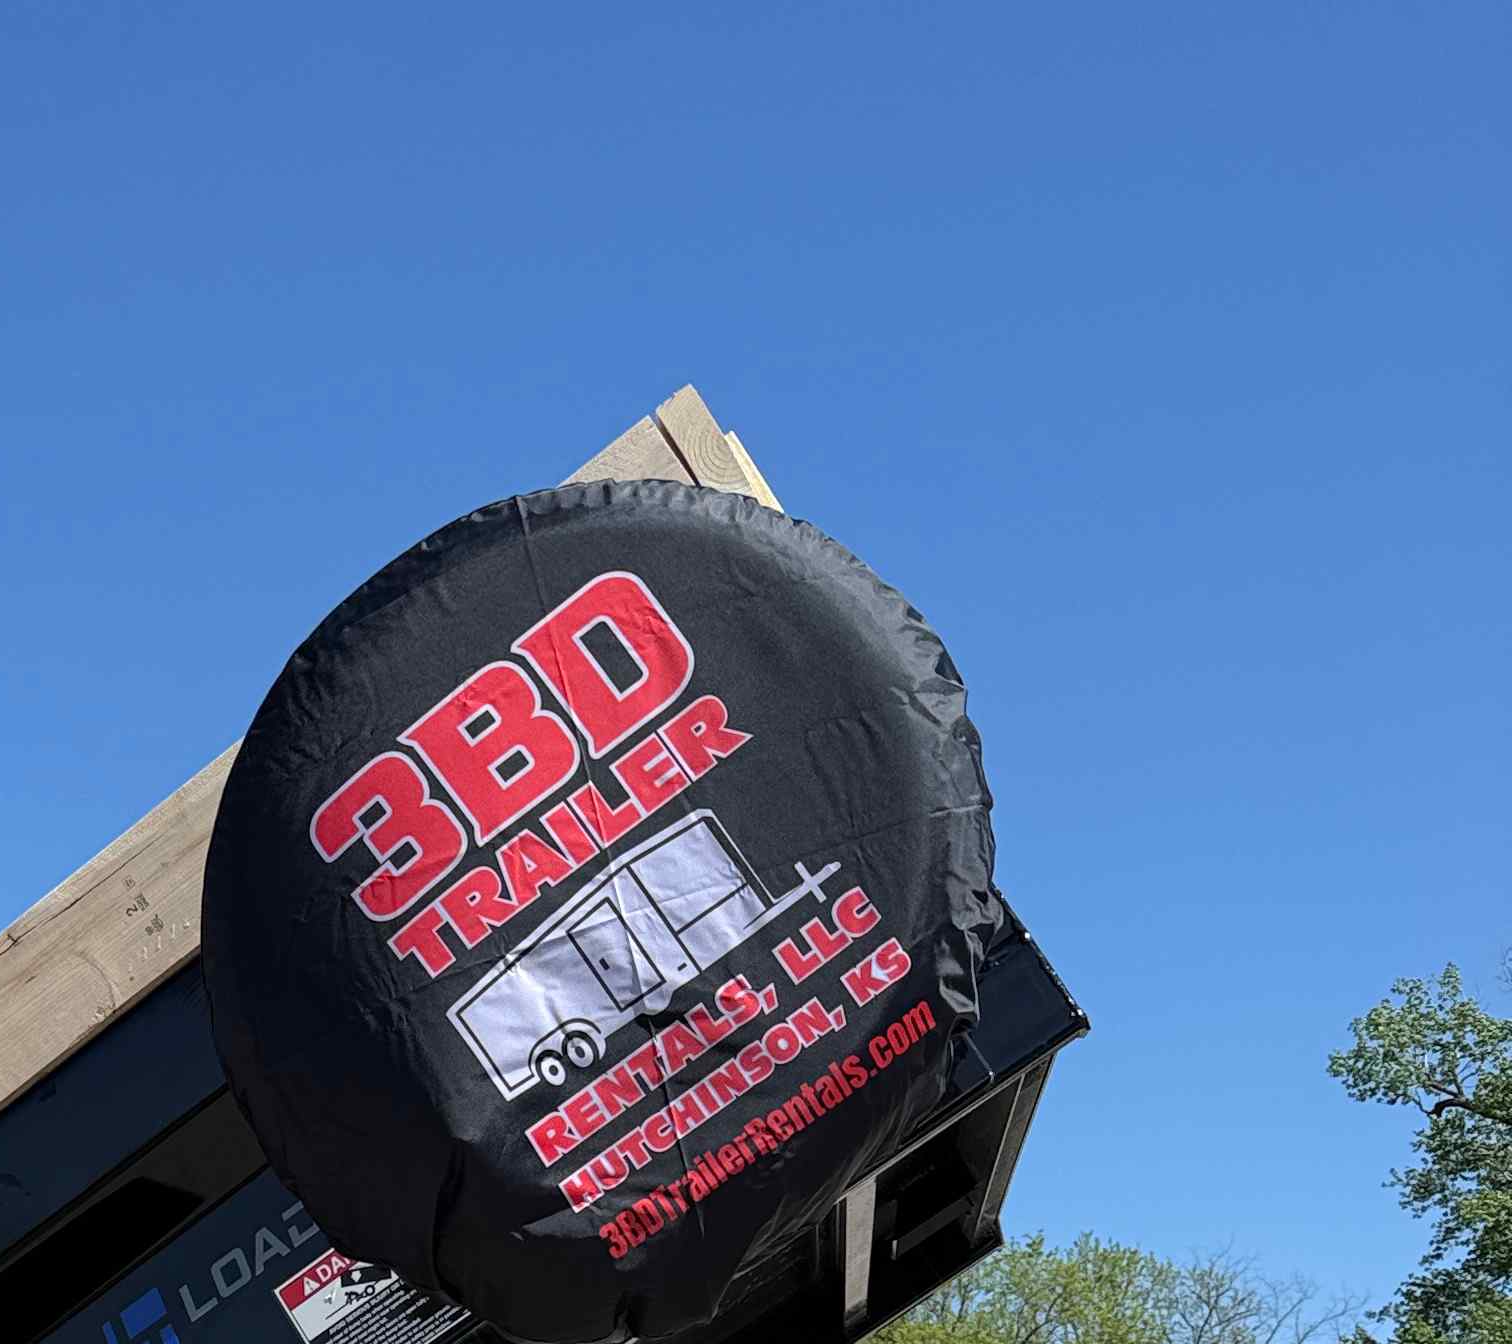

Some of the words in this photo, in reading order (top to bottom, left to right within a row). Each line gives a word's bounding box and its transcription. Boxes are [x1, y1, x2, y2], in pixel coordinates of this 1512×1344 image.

[310, 570, 694, 922] 3BD
[388, 694, 753, 979] TRAILER
[524, 975, 775, 1167] RENTALS,
[773, 886, 881, 986] LLC
[558, 997, 847, 1214] HUTCHINSON,
[842, 938, 912, 1007] KS
[597, 998, 936, 1260] 3BDTrailerRentals.com
[316, 1255, 352, 1284] DA
